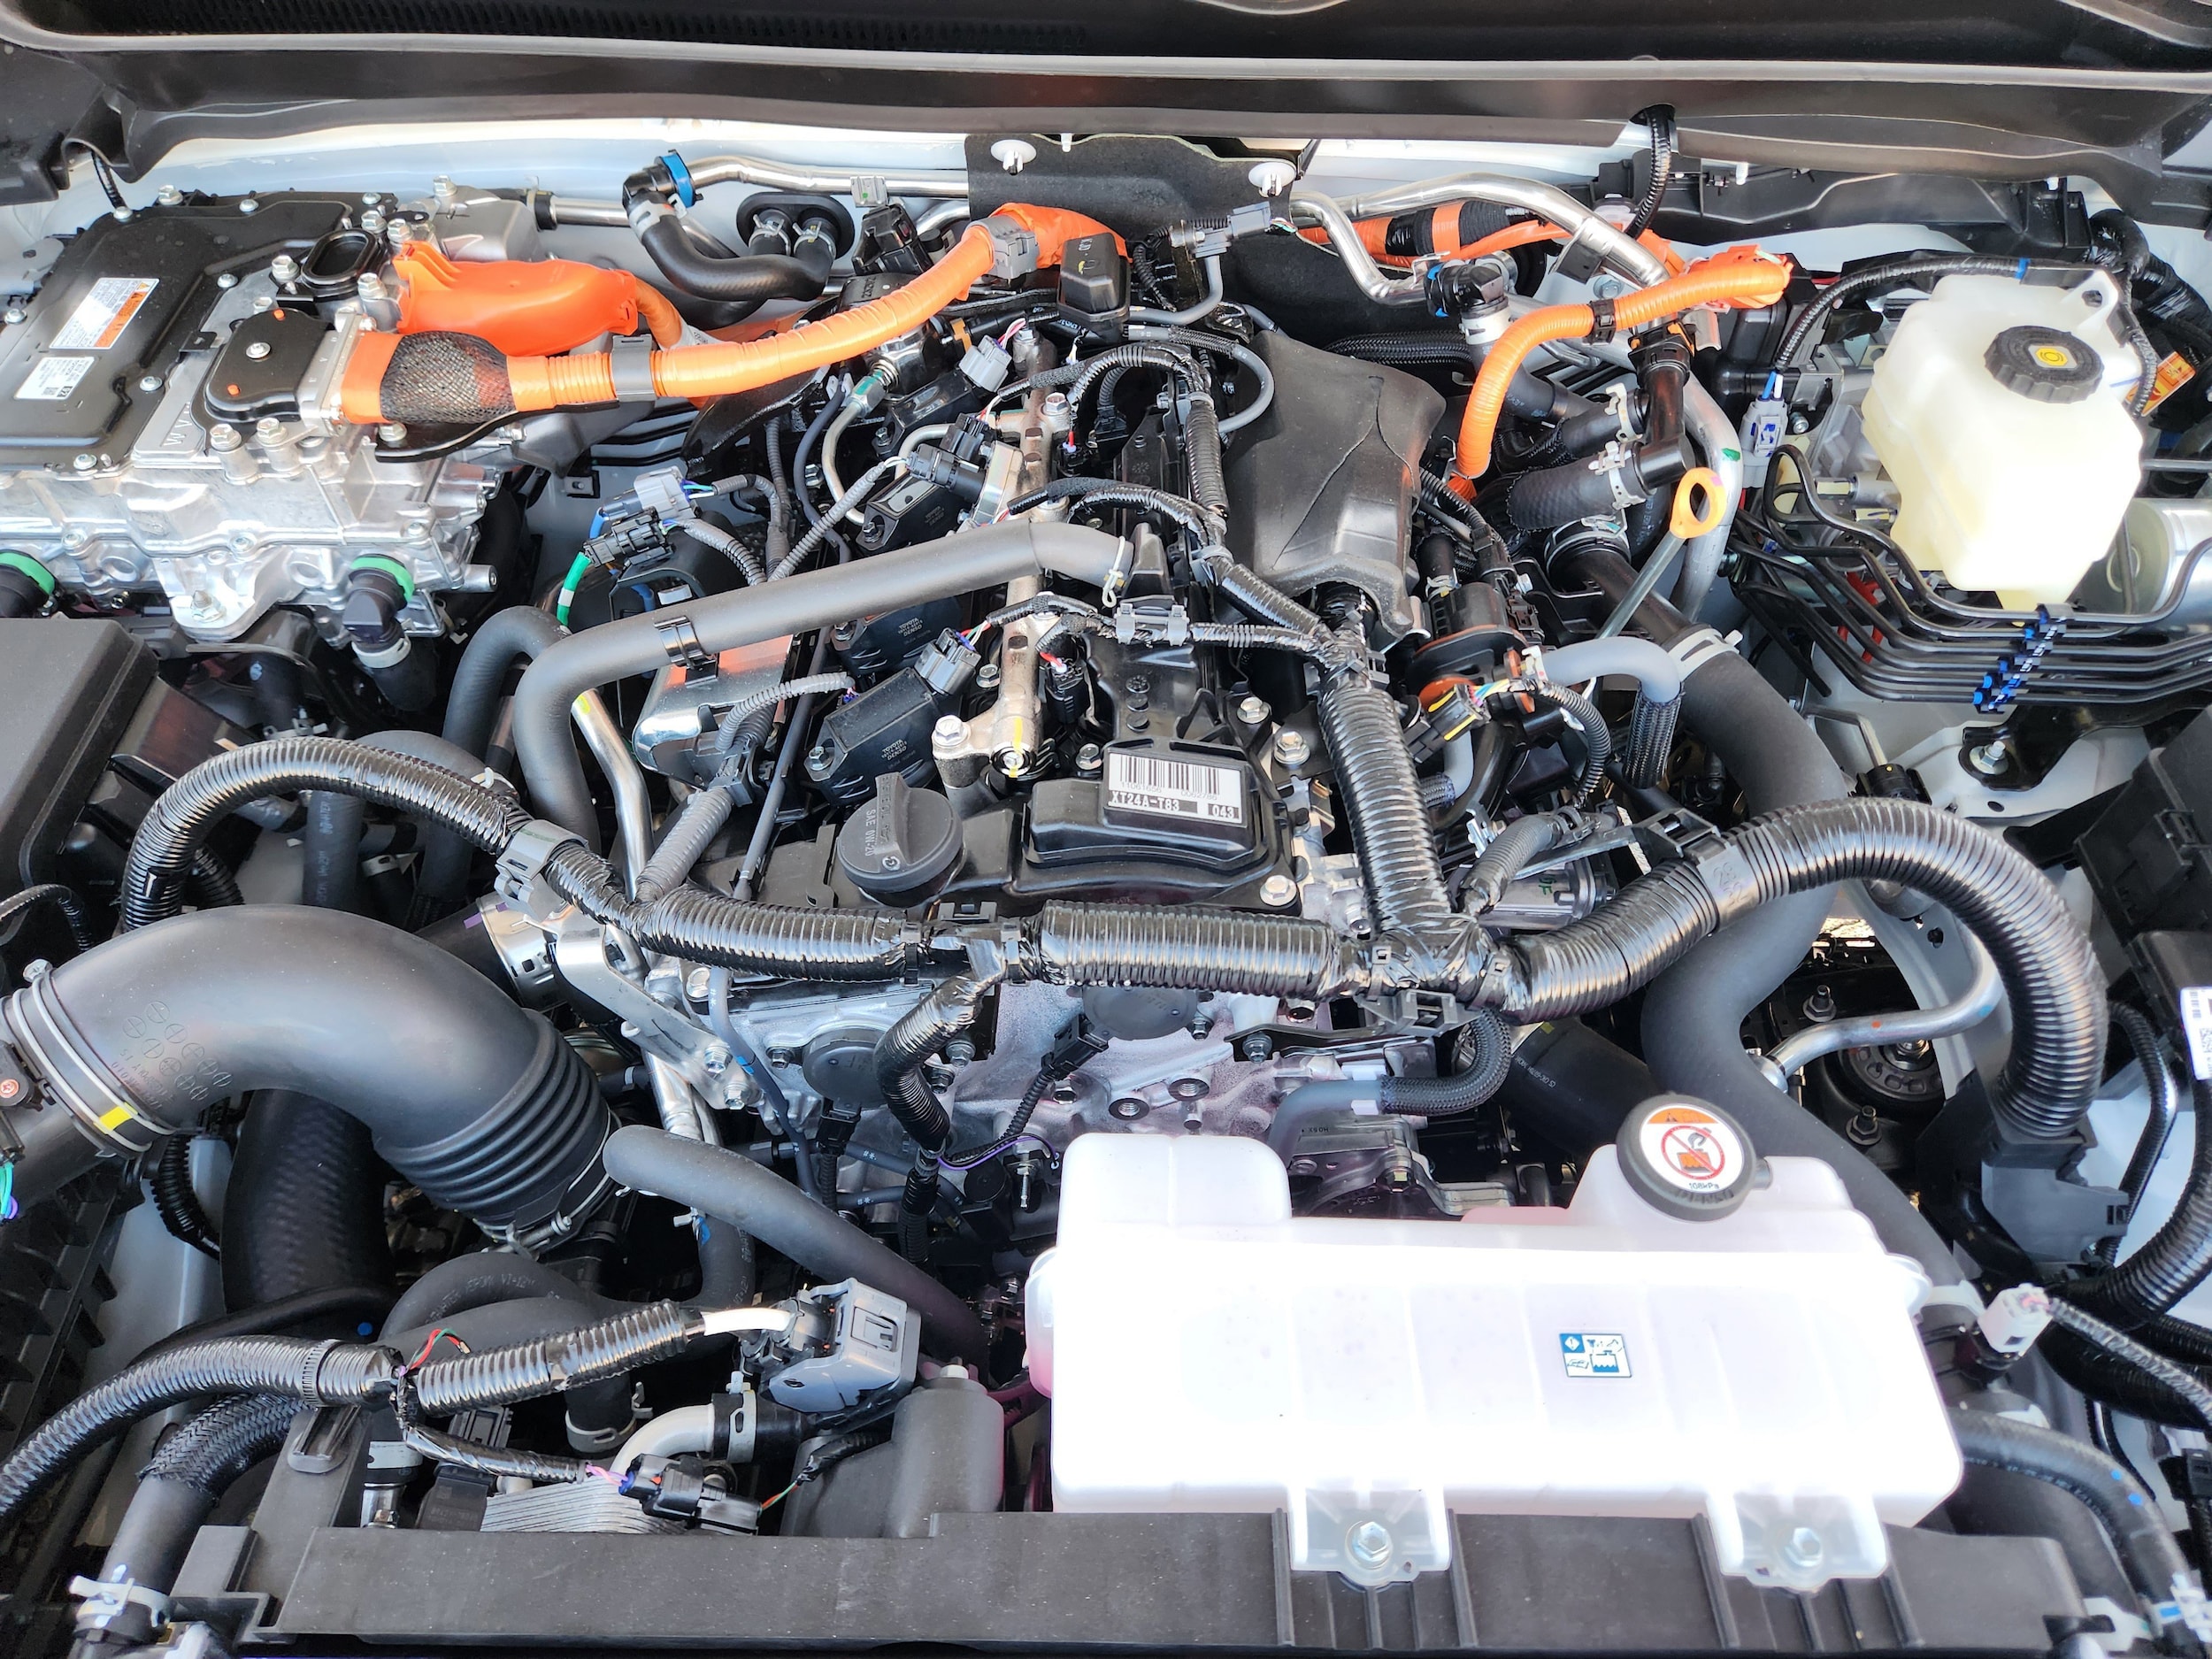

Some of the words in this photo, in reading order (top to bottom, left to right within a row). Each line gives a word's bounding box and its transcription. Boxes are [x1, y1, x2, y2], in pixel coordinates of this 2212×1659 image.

[899, 618, 920, 629] TOYOTA
[902, 624, 923, 637] DENSO
[881, 739, 904, 754] TOYOTA
[887, 746, 907, 761] DENSO
[1111, 791, 1180, 811] XT24A-T83
[1211, 804, 1235, 818] 043
[865, 808, 877, 827] SAE
[864, 828, 877, 857] 0W-20
[1688, 1181, 1720, 1191] 108kPa
